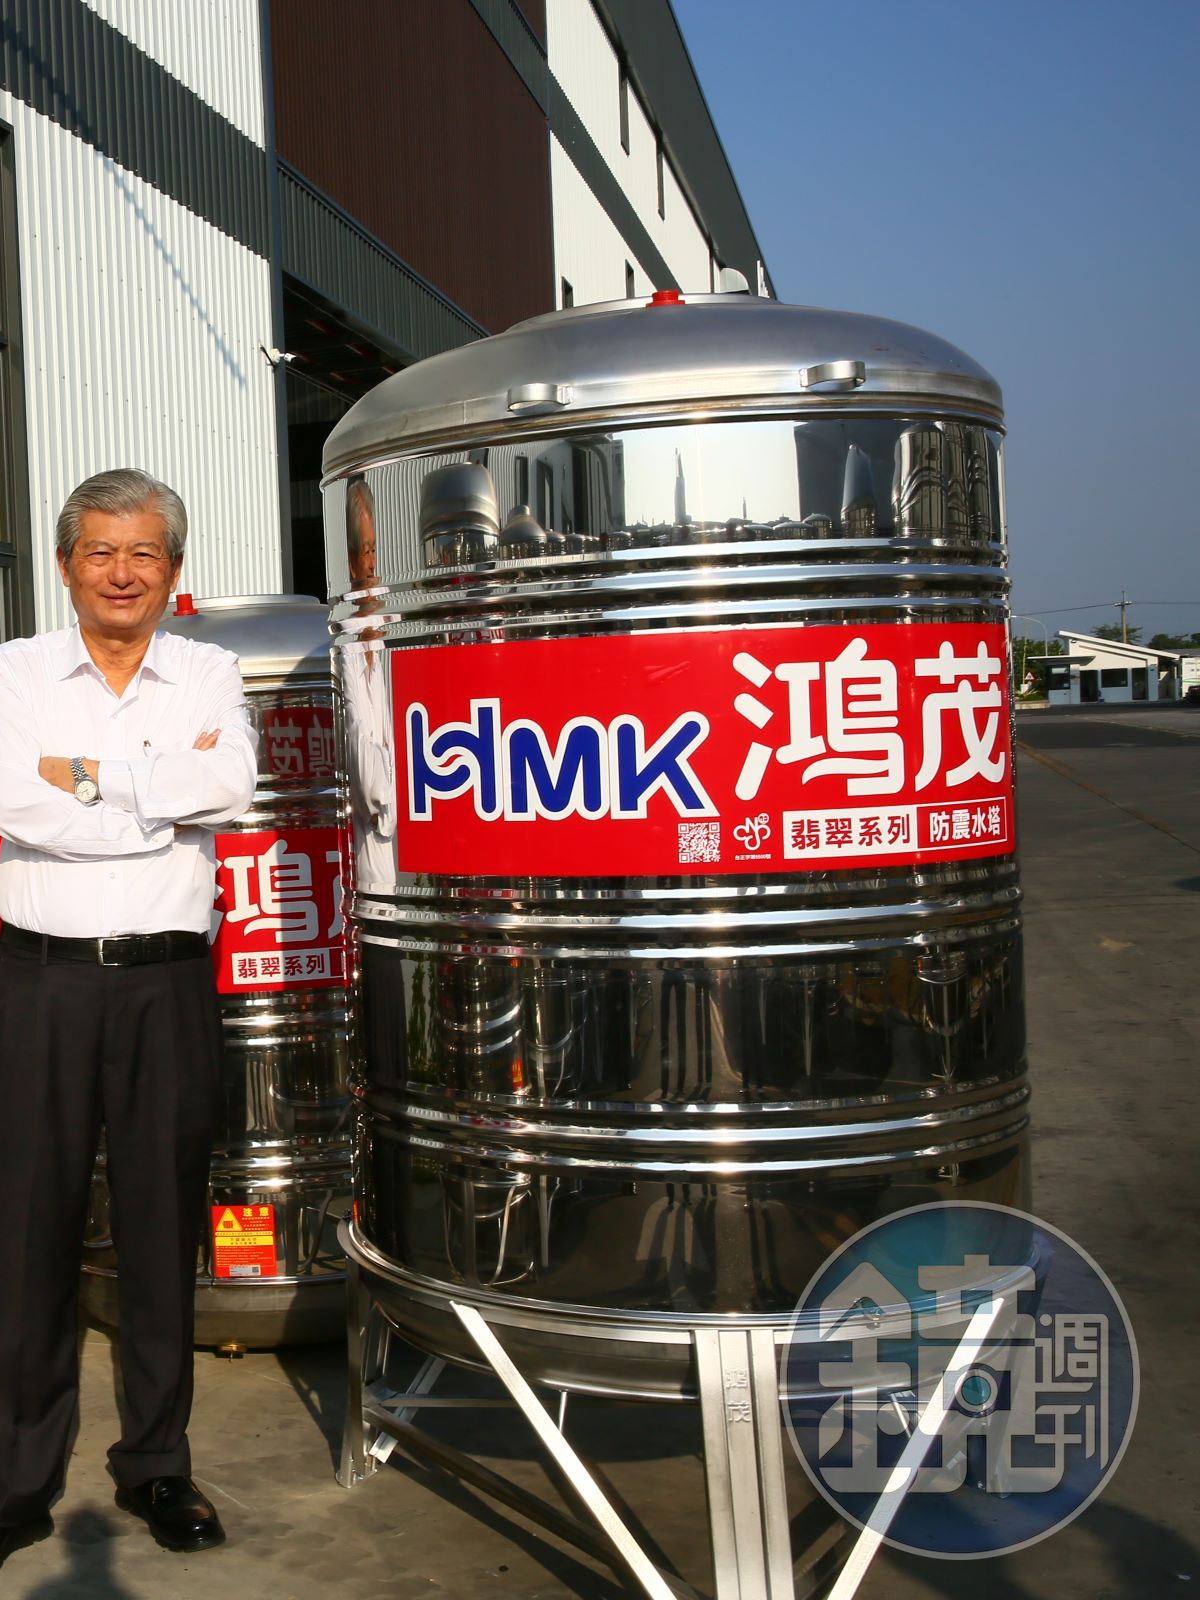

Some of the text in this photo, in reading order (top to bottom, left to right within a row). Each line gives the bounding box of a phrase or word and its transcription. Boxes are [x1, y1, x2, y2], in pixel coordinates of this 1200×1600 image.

[406, 637, 1006, 822] HMK 鴻茂
[791, 814, 911, 850] 翡翠系列
[929, 805, 1001, 843] 防震水塔
[208, 839, 342, 944] 鴻
[238, 954, 325, 978] 翡翠系列
